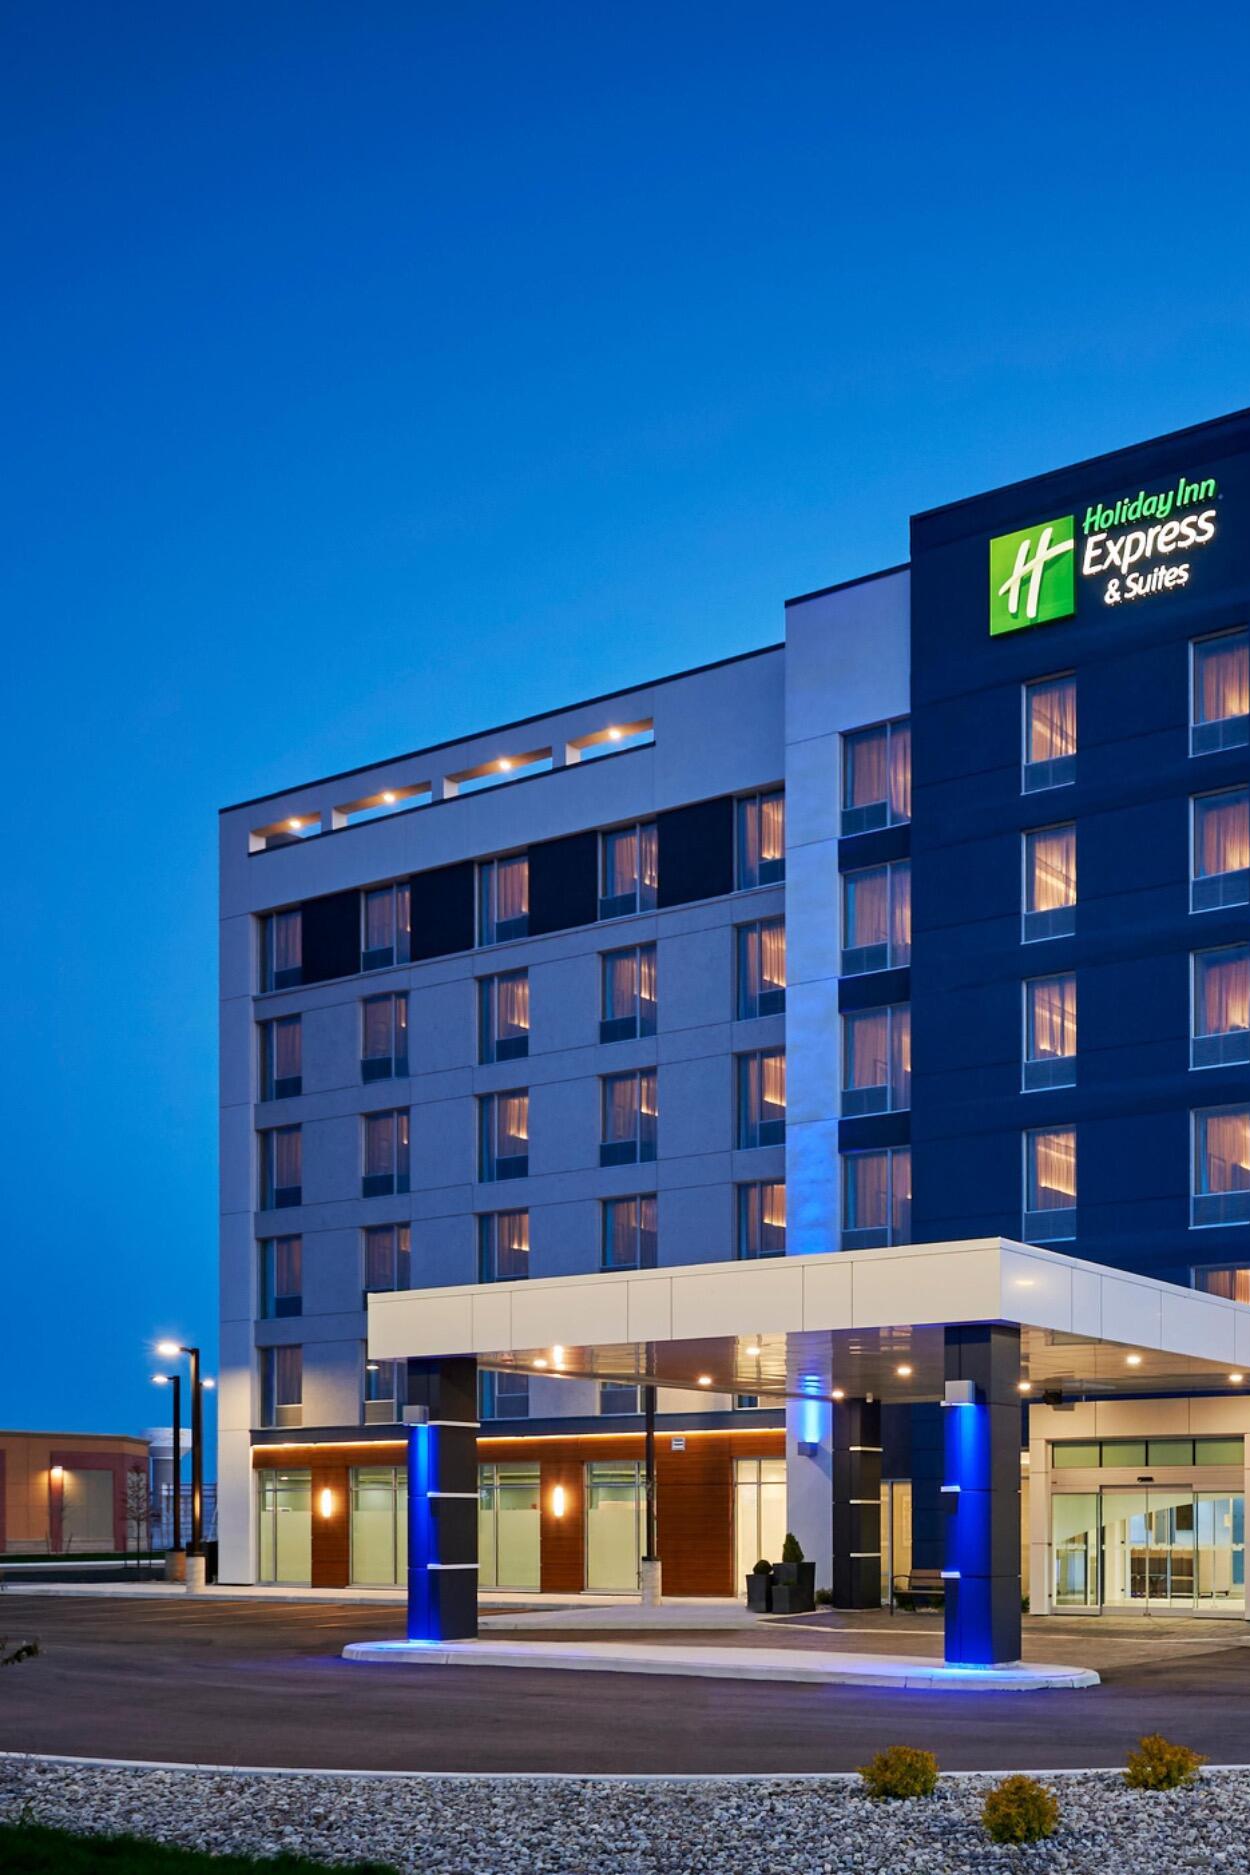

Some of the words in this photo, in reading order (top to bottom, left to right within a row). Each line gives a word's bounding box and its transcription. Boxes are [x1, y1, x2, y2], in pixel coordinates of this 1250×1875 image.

[1083, 490, 1174, 534] Holiday
[1175, 477, 1216, 507] Inn
[1082, 509, 1217, 576] Express
[1103, 578, 1121, 604] &
[1123, 563, 1190, 599] Suites
